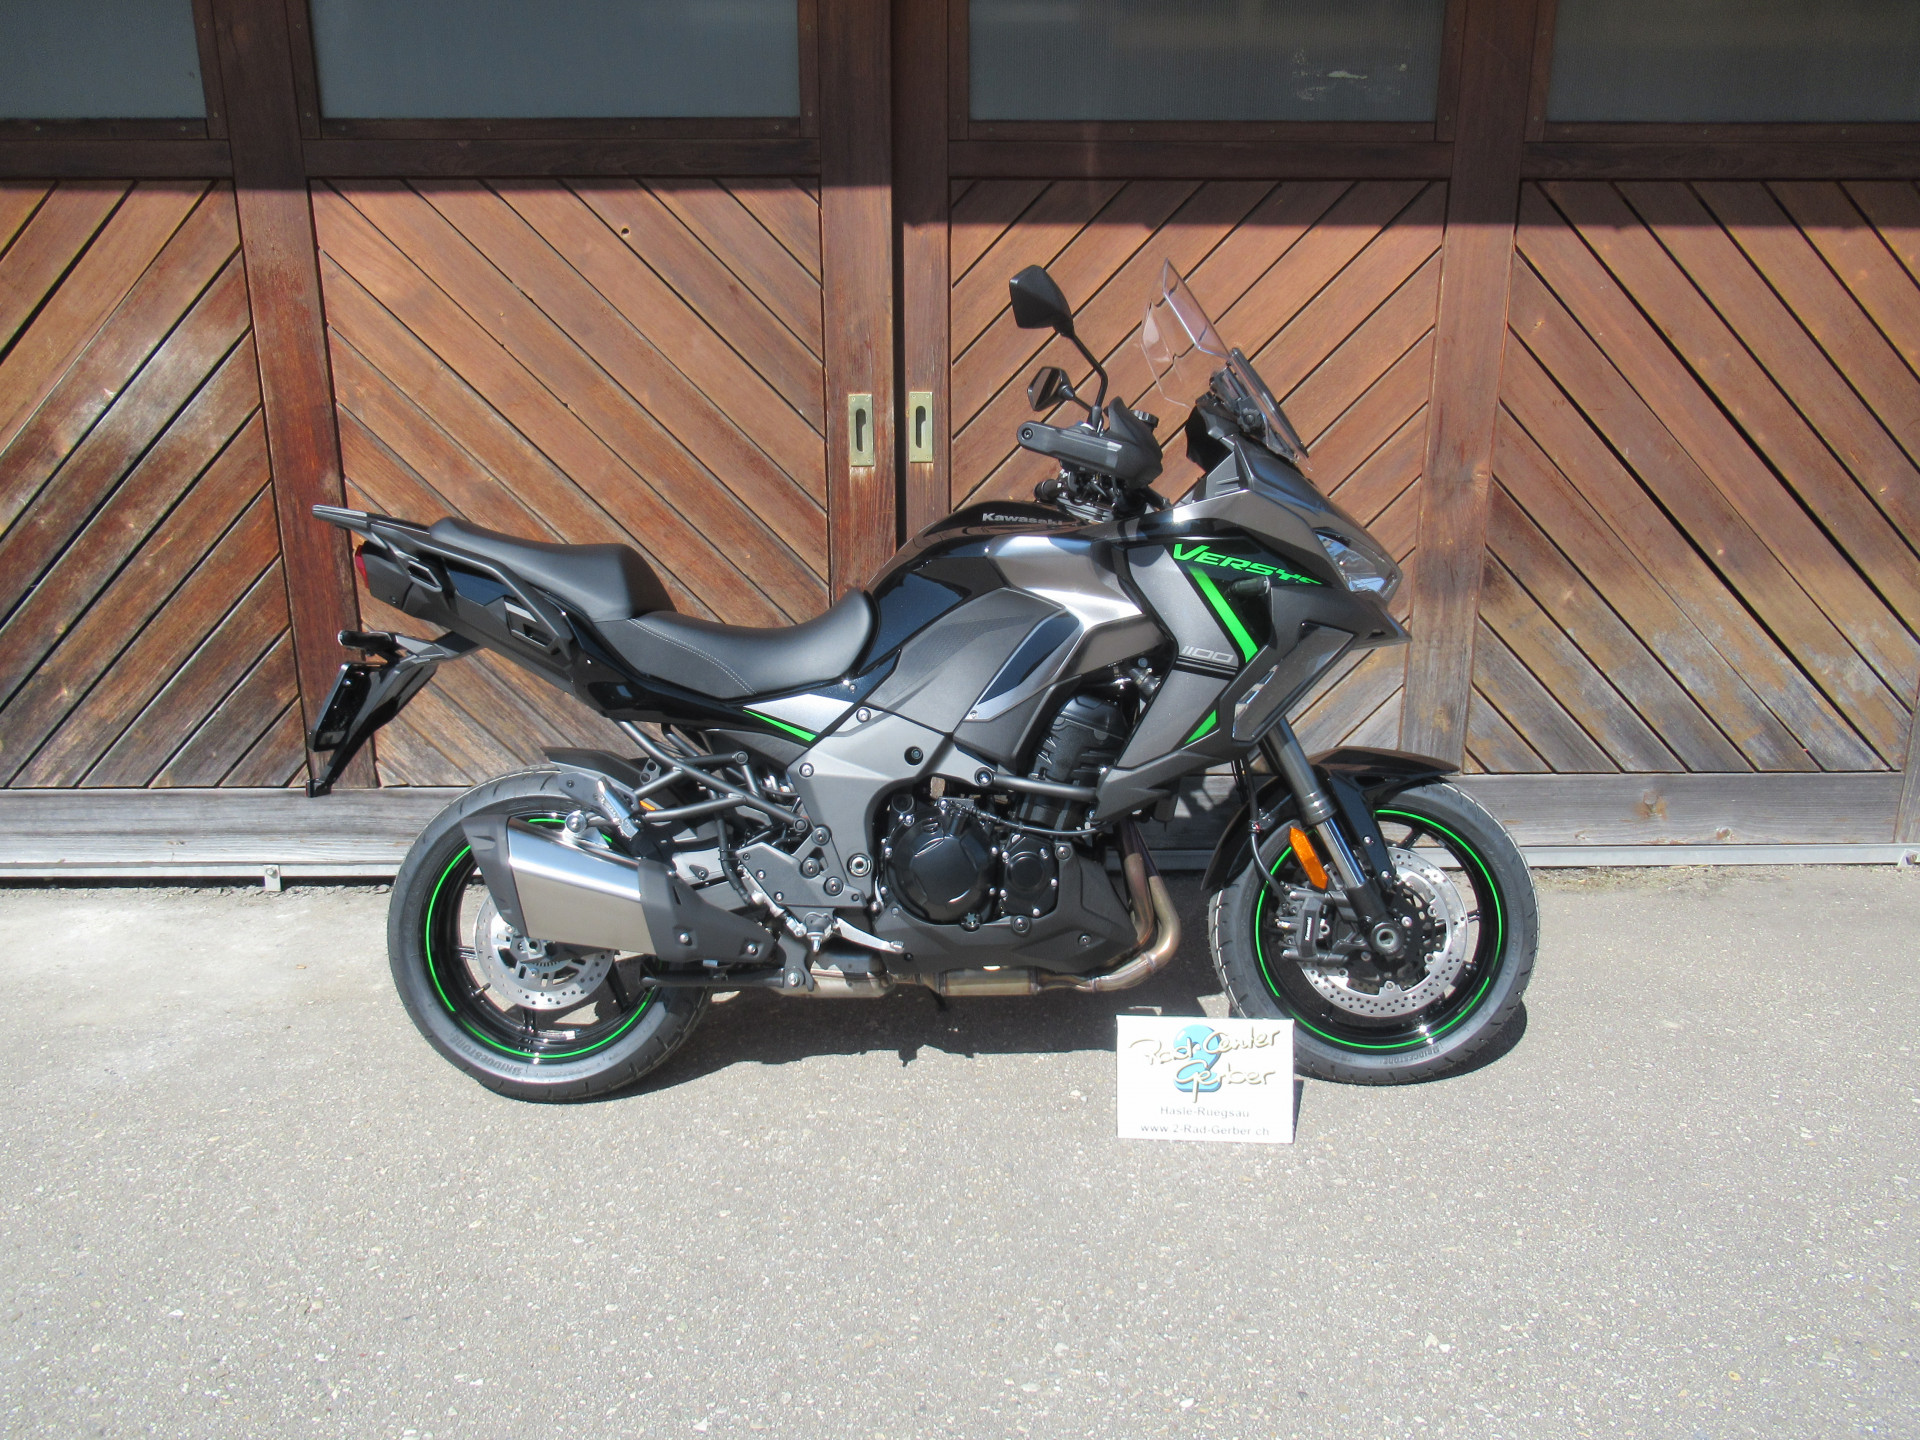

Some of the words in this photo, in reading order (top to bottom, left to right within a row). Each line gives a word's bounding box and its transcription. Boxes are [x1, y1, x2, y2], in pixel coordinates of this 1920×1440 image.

[982, 512, 1063, 526] Kawasaki
[1181, 645, 1234, 663] 1100
[1176, 1059, 1276, 1103] Gerber
[1140, 1124, 1270, 1136] www2-Rad-Gerberch
